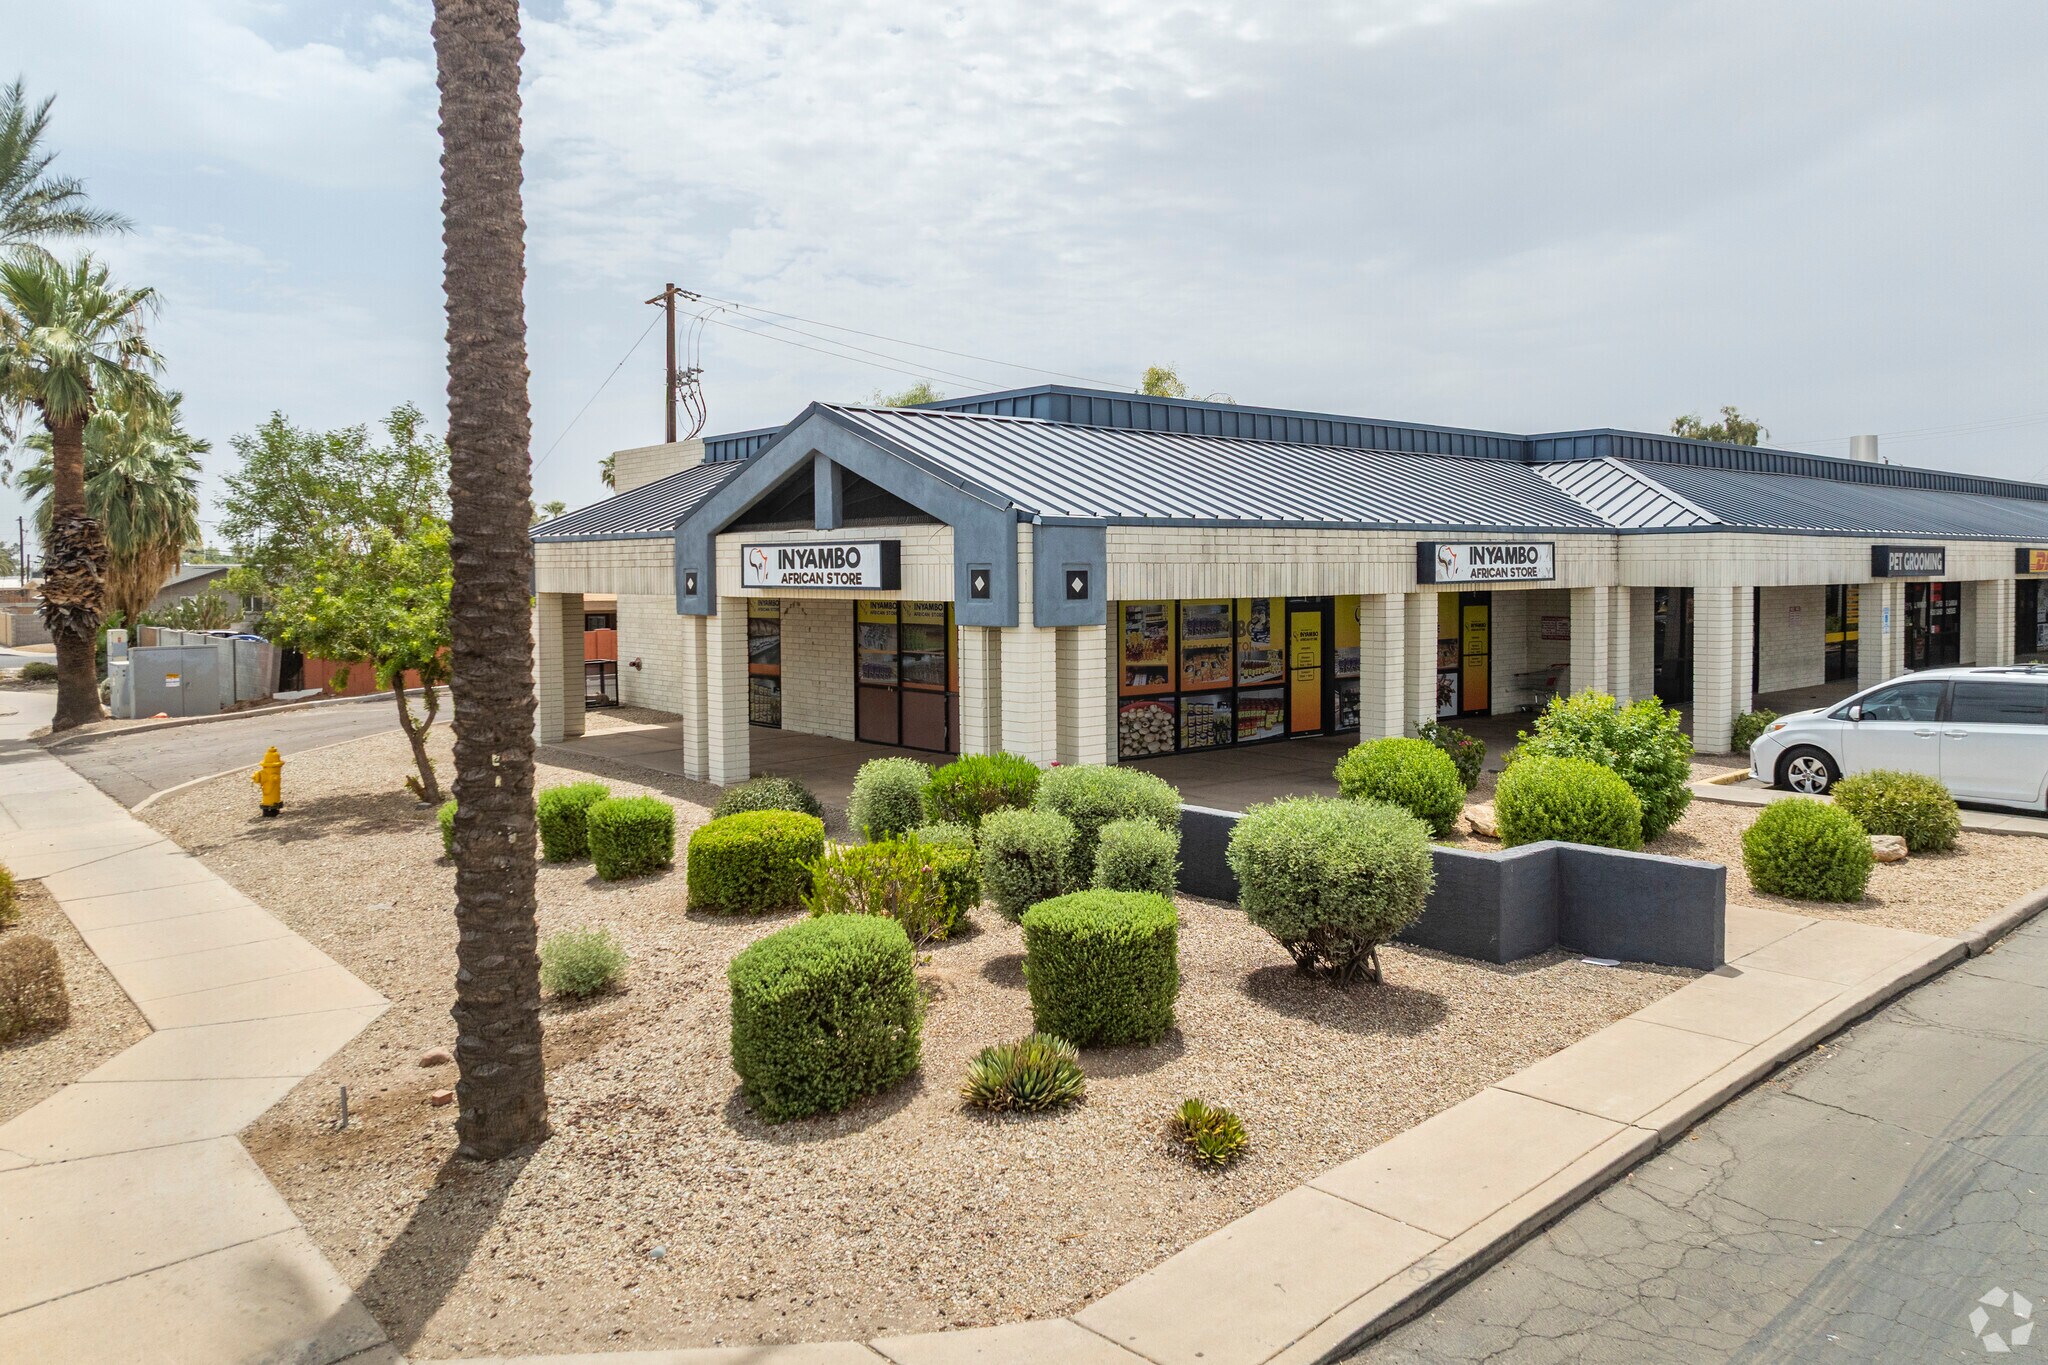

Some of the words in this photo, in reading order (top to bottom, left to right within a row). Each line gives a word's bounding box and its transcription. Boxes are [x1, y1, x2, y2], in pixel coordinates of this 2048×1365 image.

[778, 547, 861, 570] INYAMBO
[1469, 546, 1538, 565] INYAMBO
[1889, 552, 1903, 570] PET
[1903, 551, 1943, 570] GROOMING
[781, 573, 824, 585] AFRICAN
[826, 573, 862, 585] STORE
[1470, 567, 1508, 579] AFRICAN
[1510, 567, 1538, 578] STORE
[870, 601, 897, 609] INYAMBO
[914, 603, 943, 611] INYAMBO
